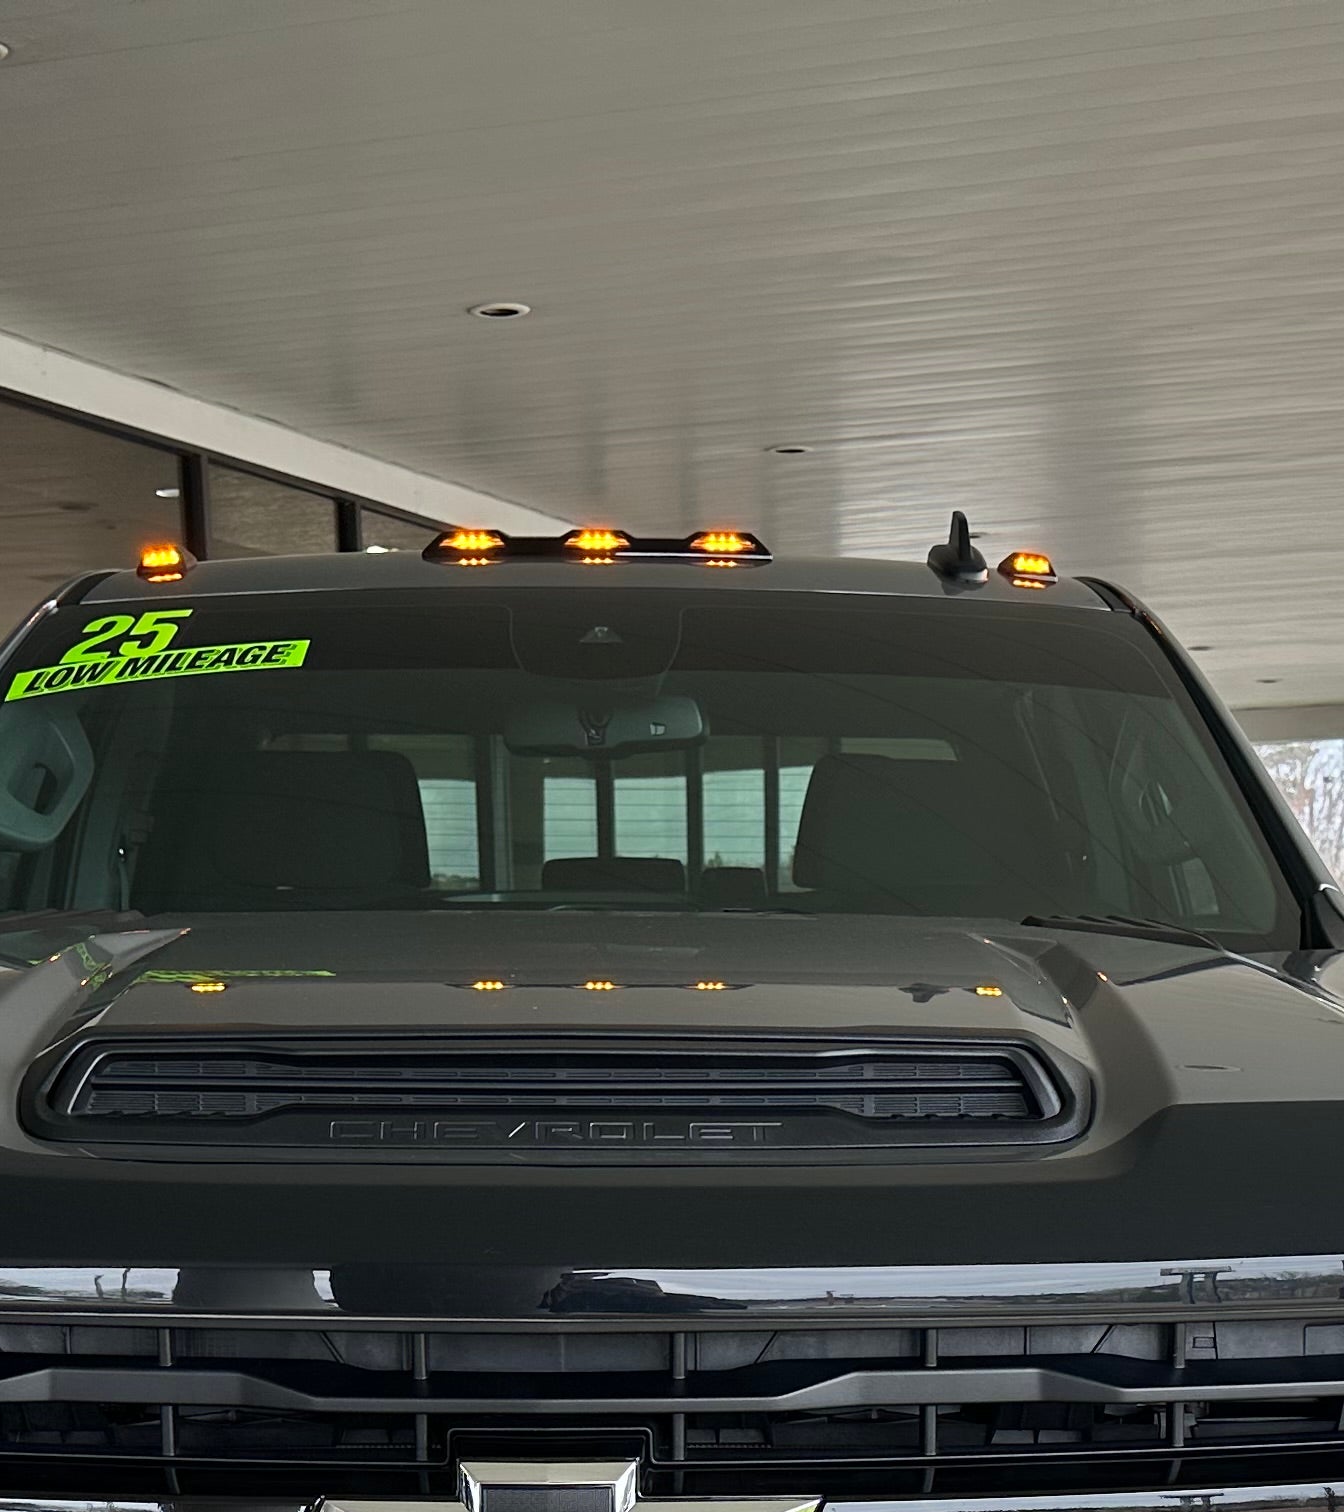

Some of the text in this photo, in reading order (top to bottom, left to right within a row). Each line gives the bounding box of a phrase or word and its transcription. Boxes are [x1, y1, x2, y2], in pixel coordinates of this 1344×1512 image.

[59, 609, 193, 664] 25
[24, 643, 298, 695] LOW MILEAGE
[329, 1120, 783, 1141] CHEVROLET
